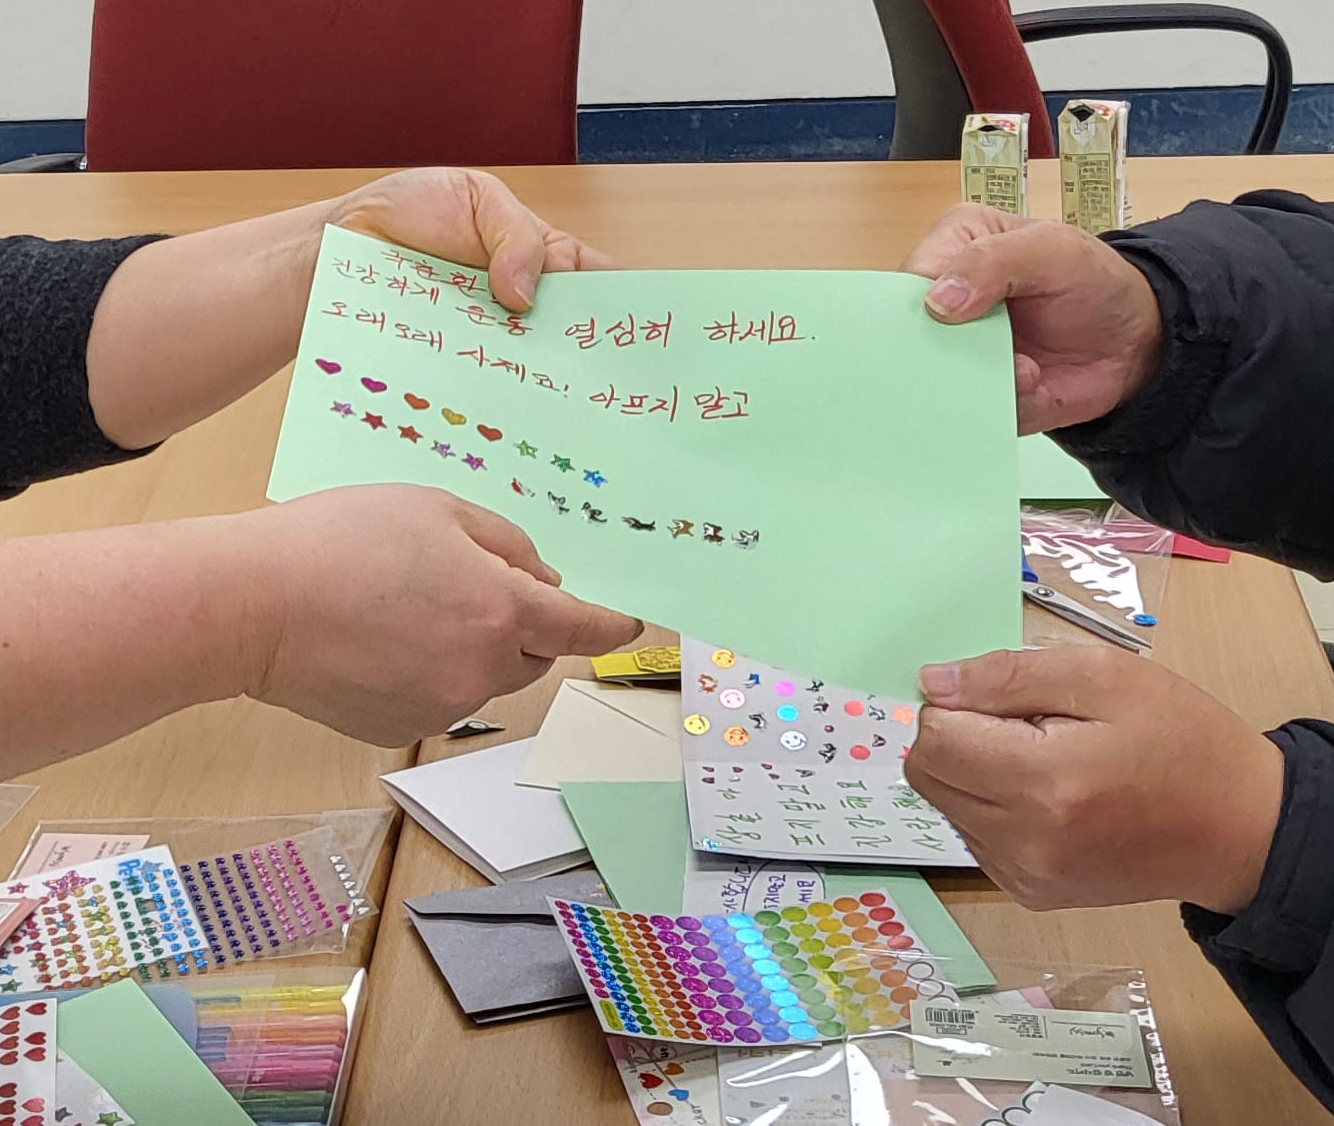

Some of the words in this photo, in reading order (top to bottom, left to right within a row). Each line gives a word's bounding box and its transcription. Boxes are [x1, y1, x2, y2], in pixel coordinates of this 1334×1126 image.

[564, 310, 672, 350] 열심히
[588, 383, 678, 423] 아프지
[693, 385, 750, 421] 말고
